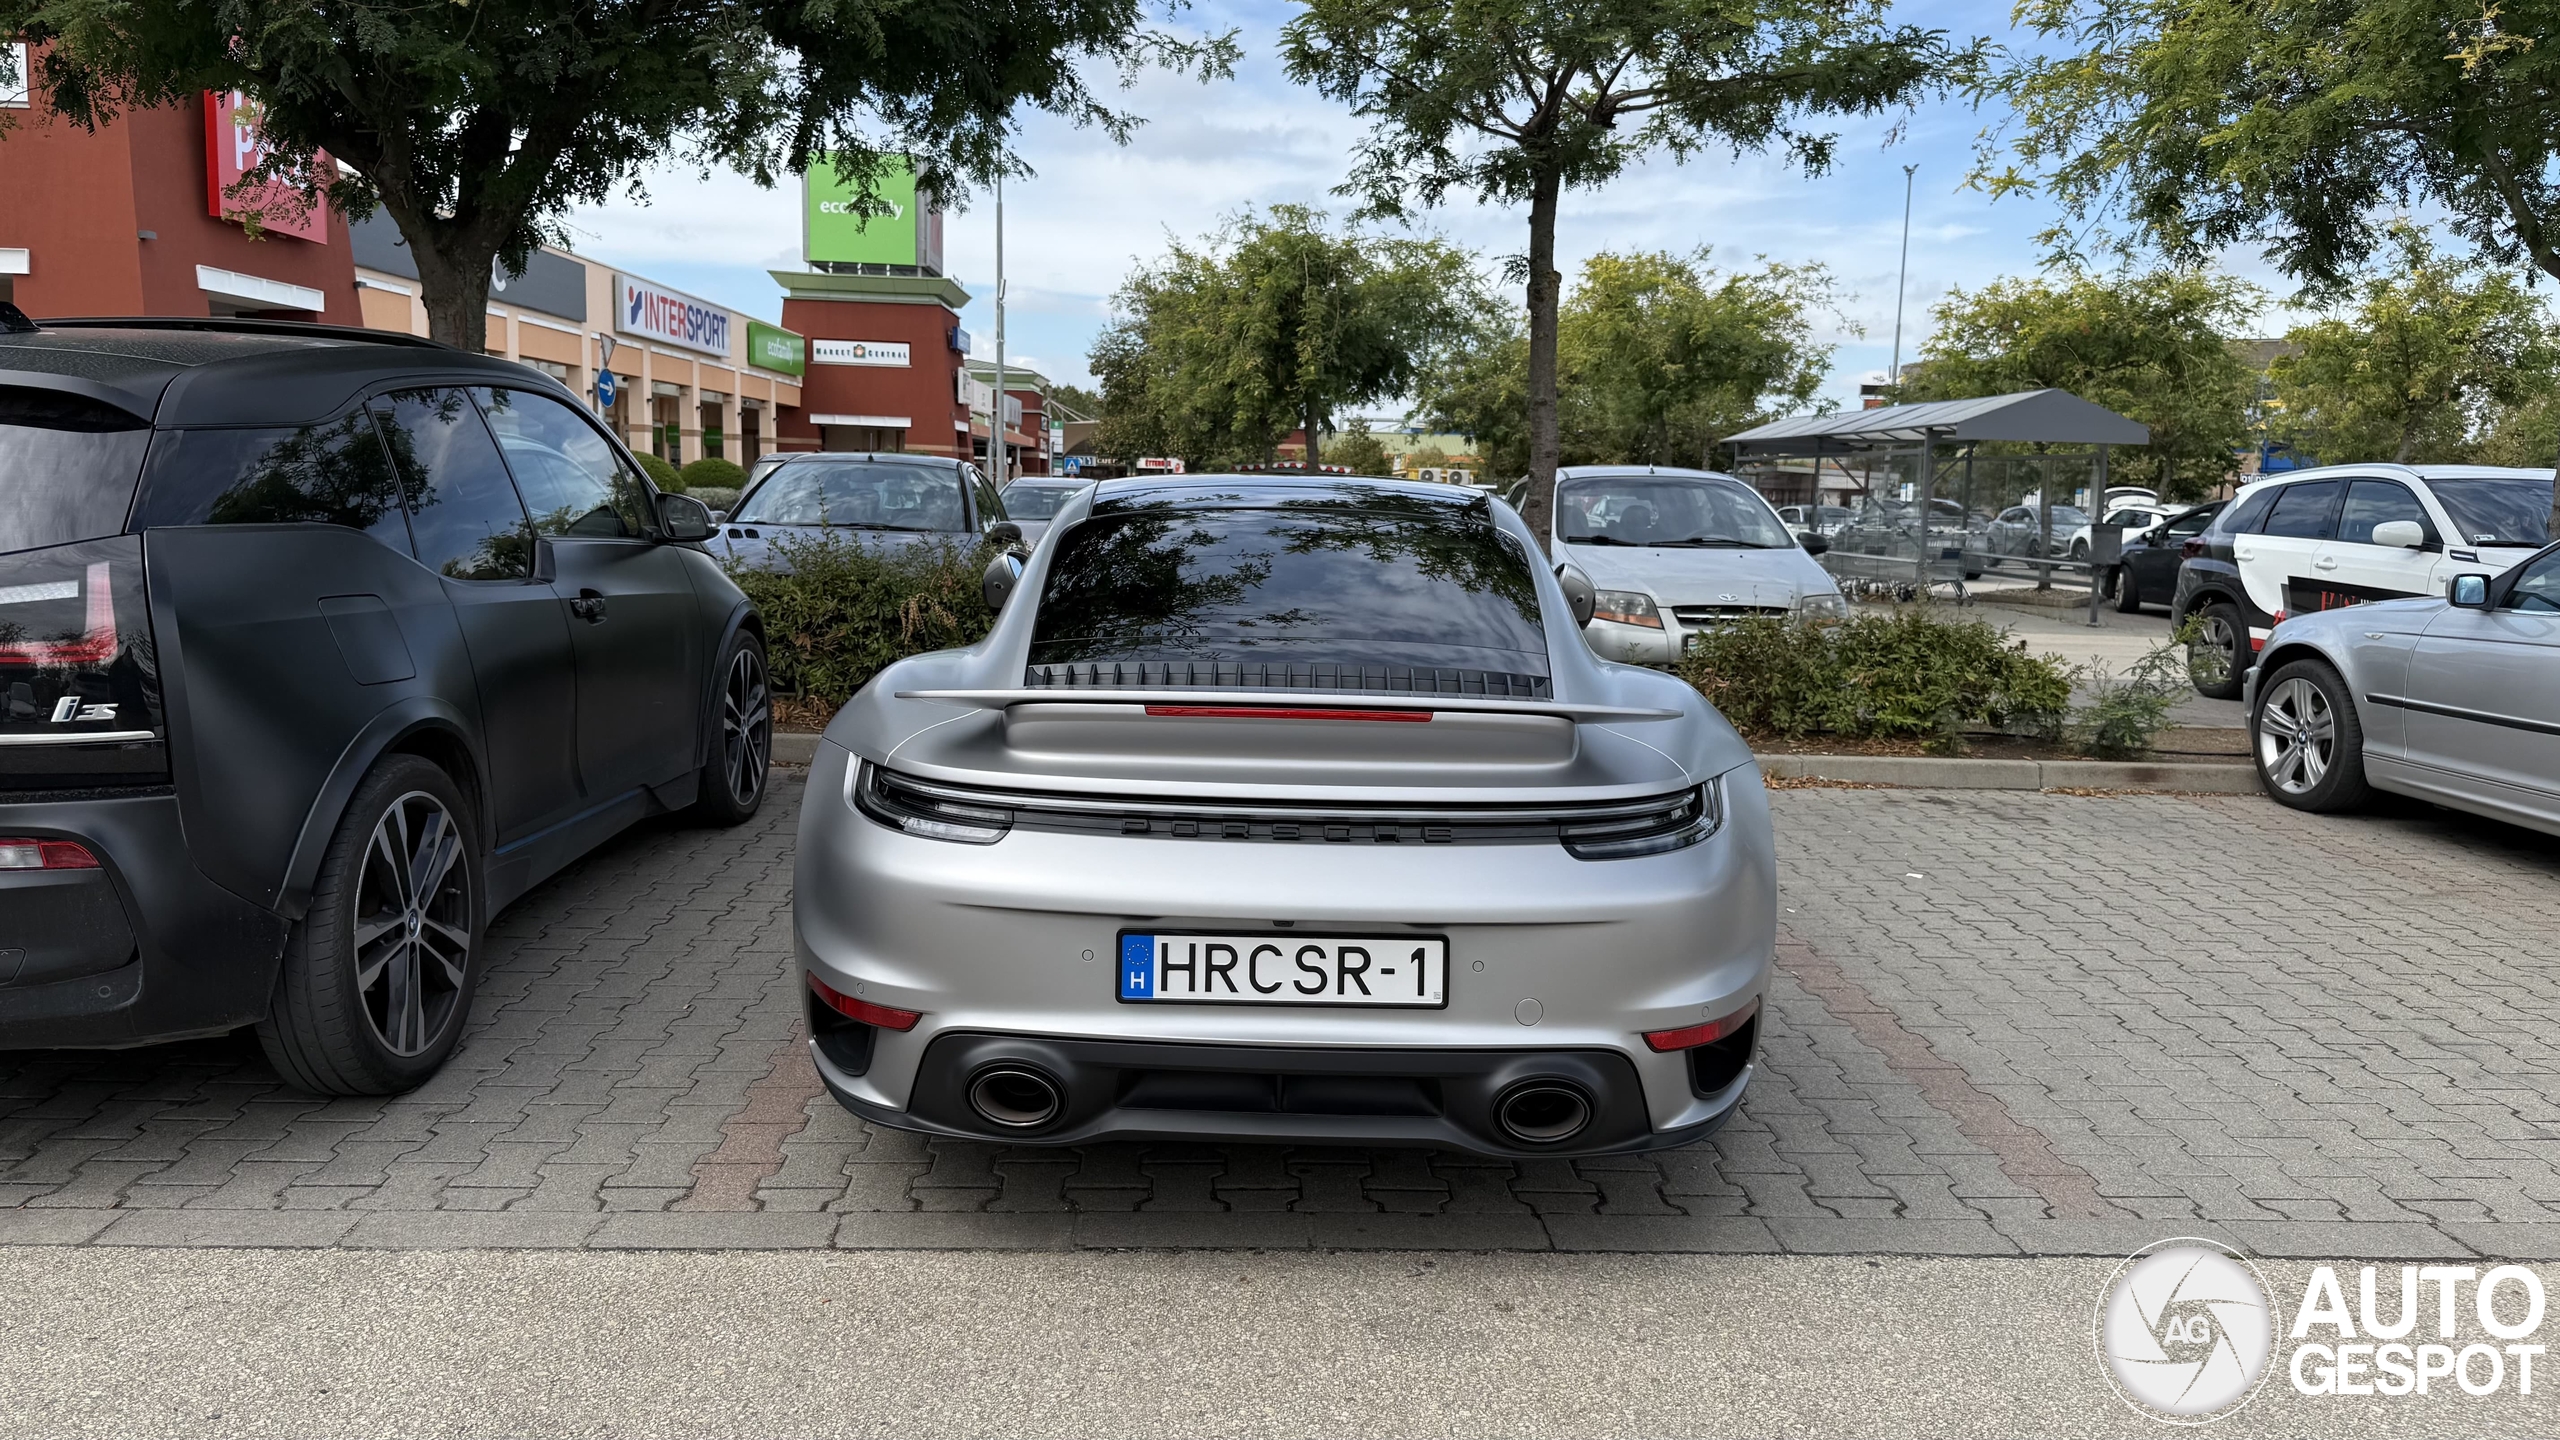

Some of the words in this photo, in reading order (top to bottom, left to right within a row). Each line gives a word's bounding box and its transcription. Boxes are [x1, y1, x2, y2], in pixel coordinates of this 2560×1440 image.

[644, 290, 727, 350] INTERSPORT
[816, 347, 850, 356] MARKET
[868, 349, 907, 359] CENTRAL
[1121, 818, 1452, 843] PORSCHE
[1130, 971, 1145, 990] H
[1160, 942, 1426, 997] HRCSR-1
